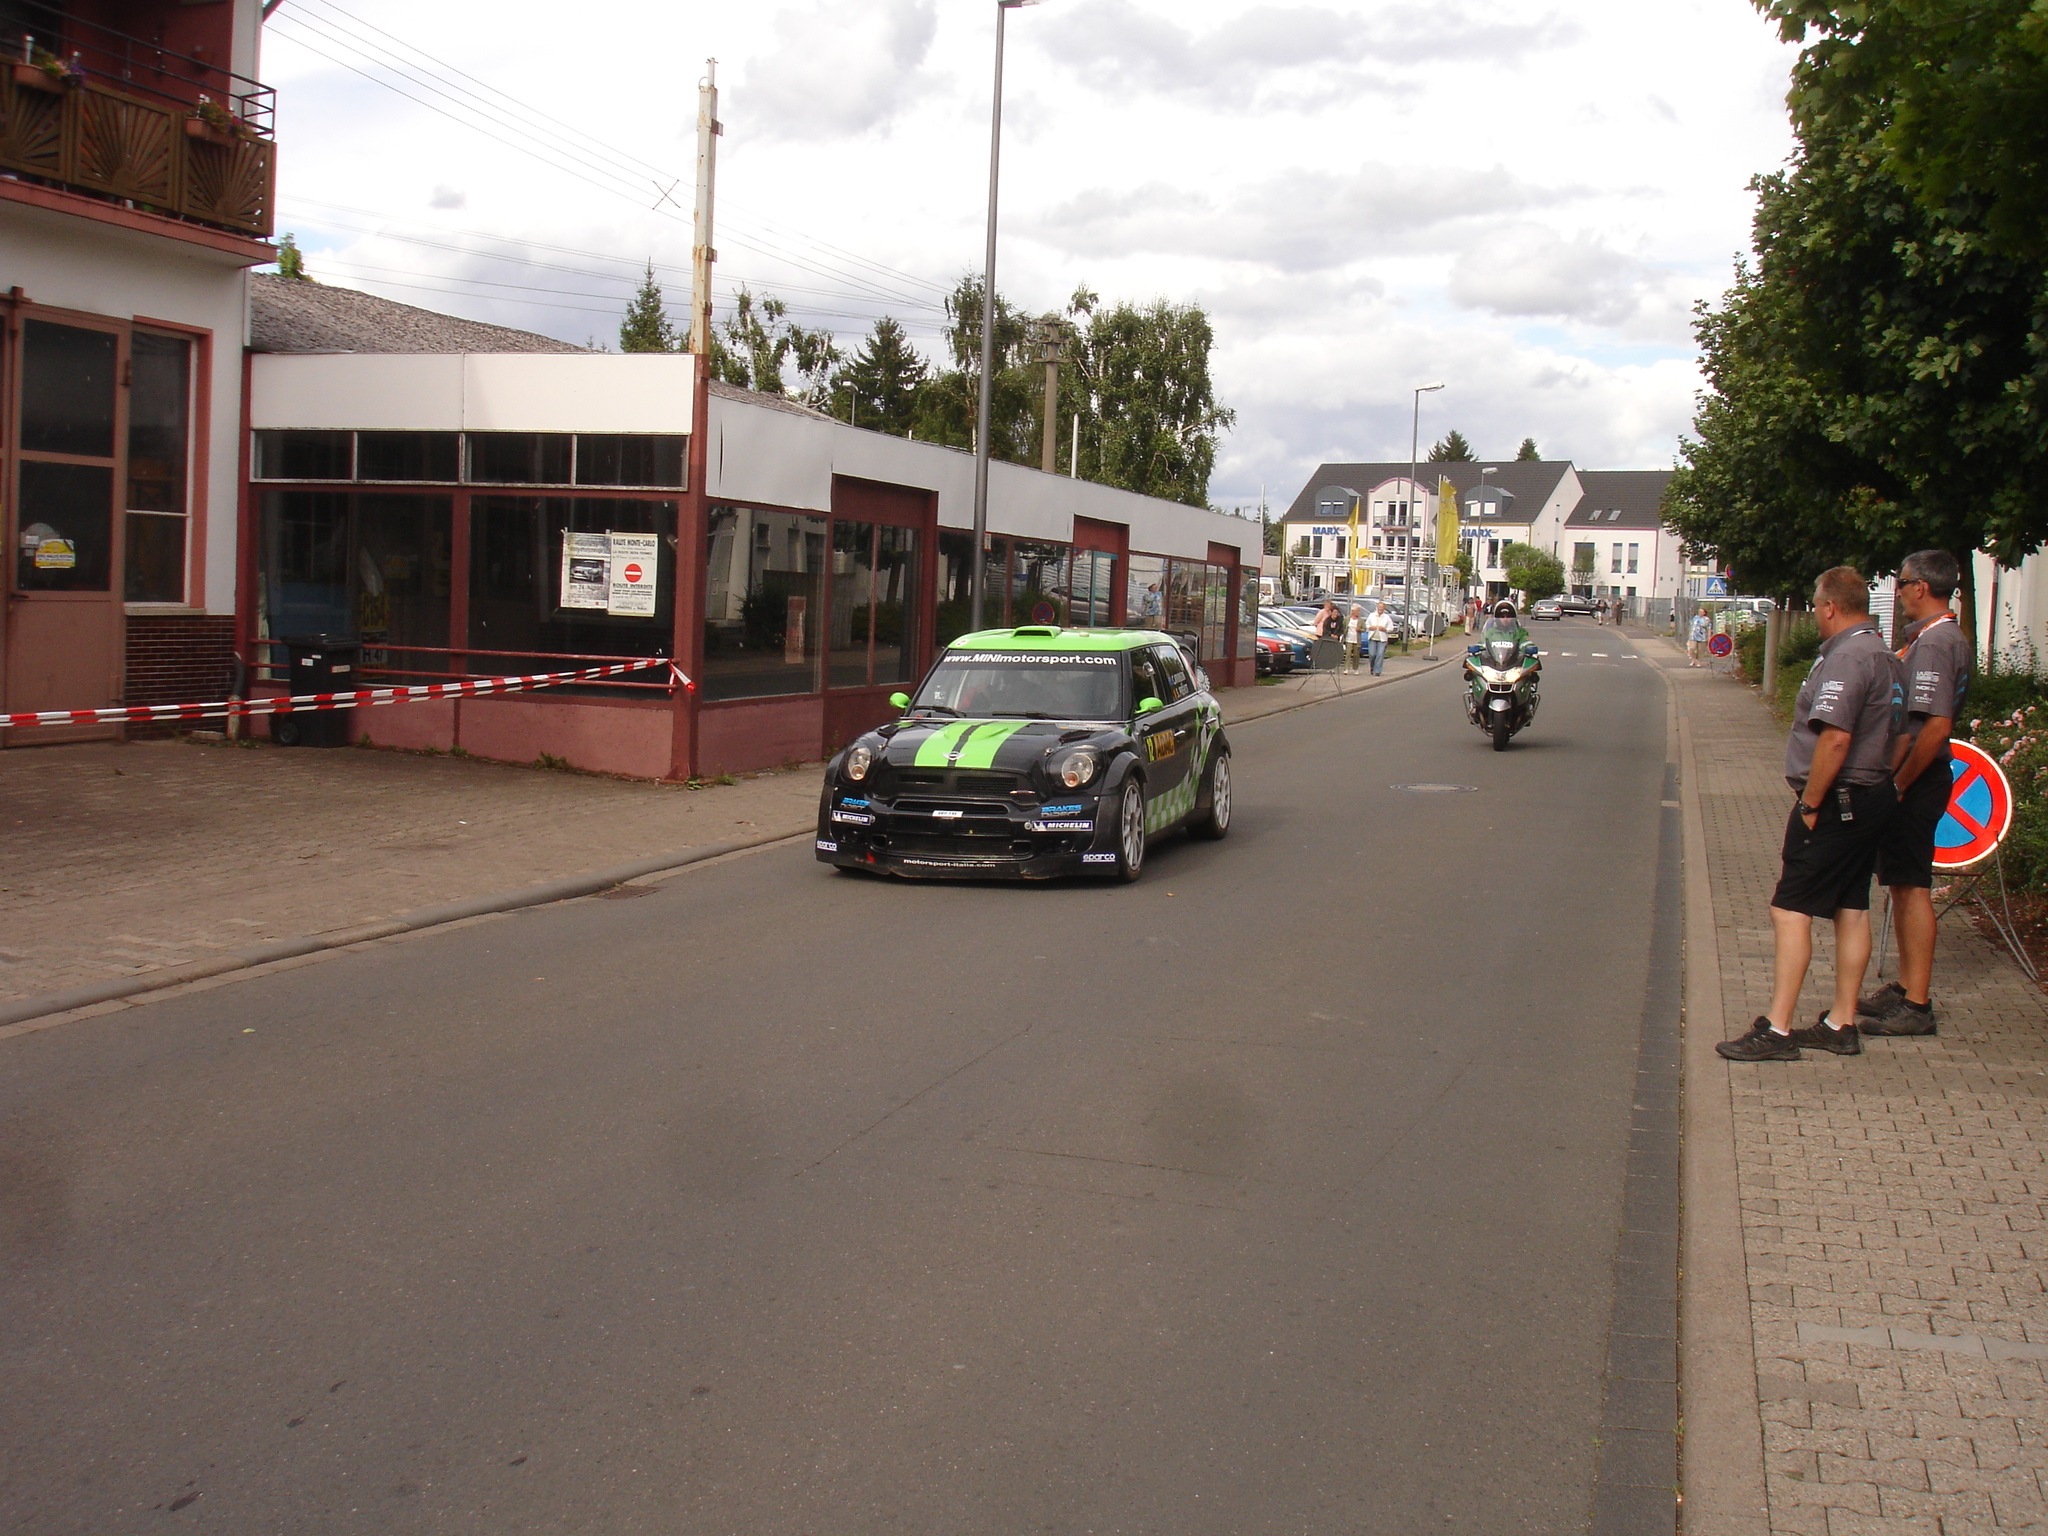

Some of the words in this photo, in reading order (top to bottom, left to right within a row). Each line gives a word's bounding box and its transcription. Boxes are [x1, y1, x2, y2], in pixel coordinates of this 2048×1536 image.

[1312, 527, 1341, 535] MARX
[1461, 528, 1492, 538] MARX
[627, 539, 656, 547] MONTE-CARLO
[943, 653, 1117, 665] www.MINImotorsport.com
[842, 814, 869, 822] MICHELIN
[817, 840, 838, 850] sparco
[1083, 853, 1116, 861] sparco
[903, 859, 996, 868] motorsport-italia.com
